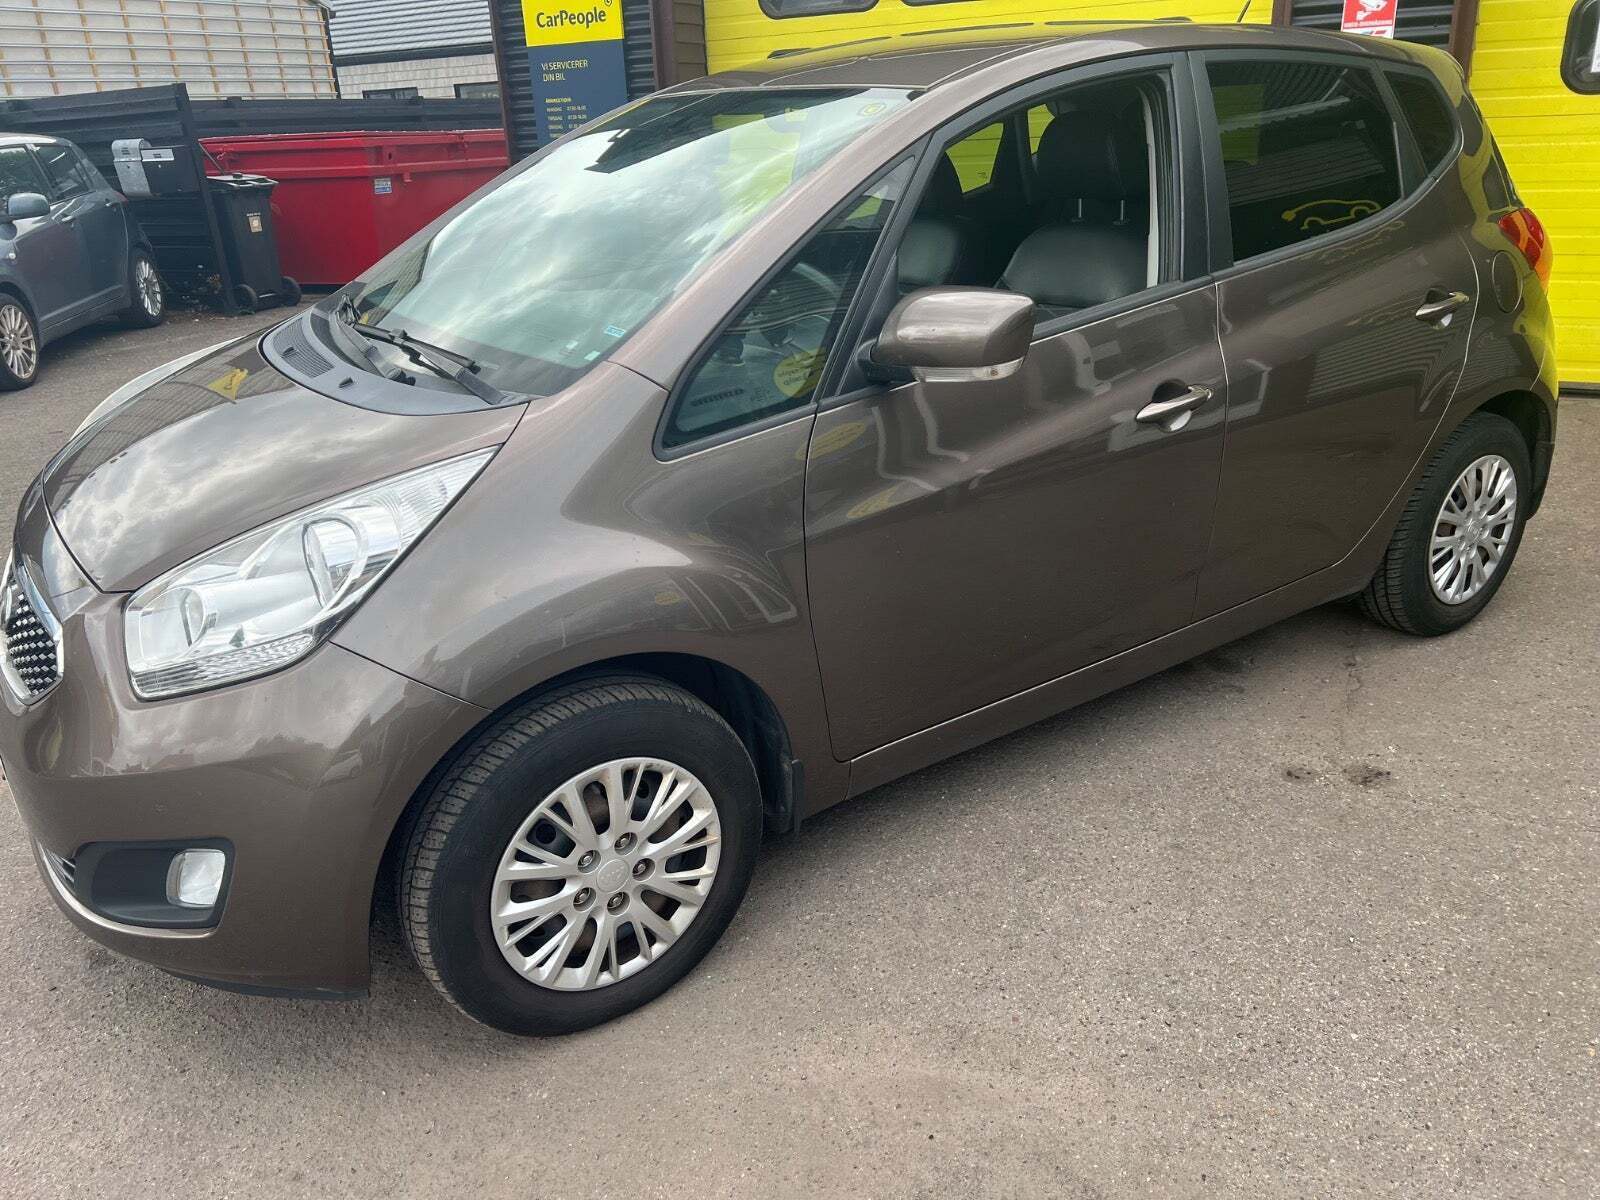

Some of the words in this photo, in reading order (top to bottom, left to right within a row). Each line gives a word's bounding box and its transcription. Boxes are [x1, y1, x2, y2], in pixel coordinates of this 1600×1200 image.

[536, 7, 606, 29] CarPeople
[541, 62, 549, 71] VI
[549, 59, 588, 71] SERVICERER
[543, 73, 555, 82] DIN
[555, 72, 566, 81] BIL
